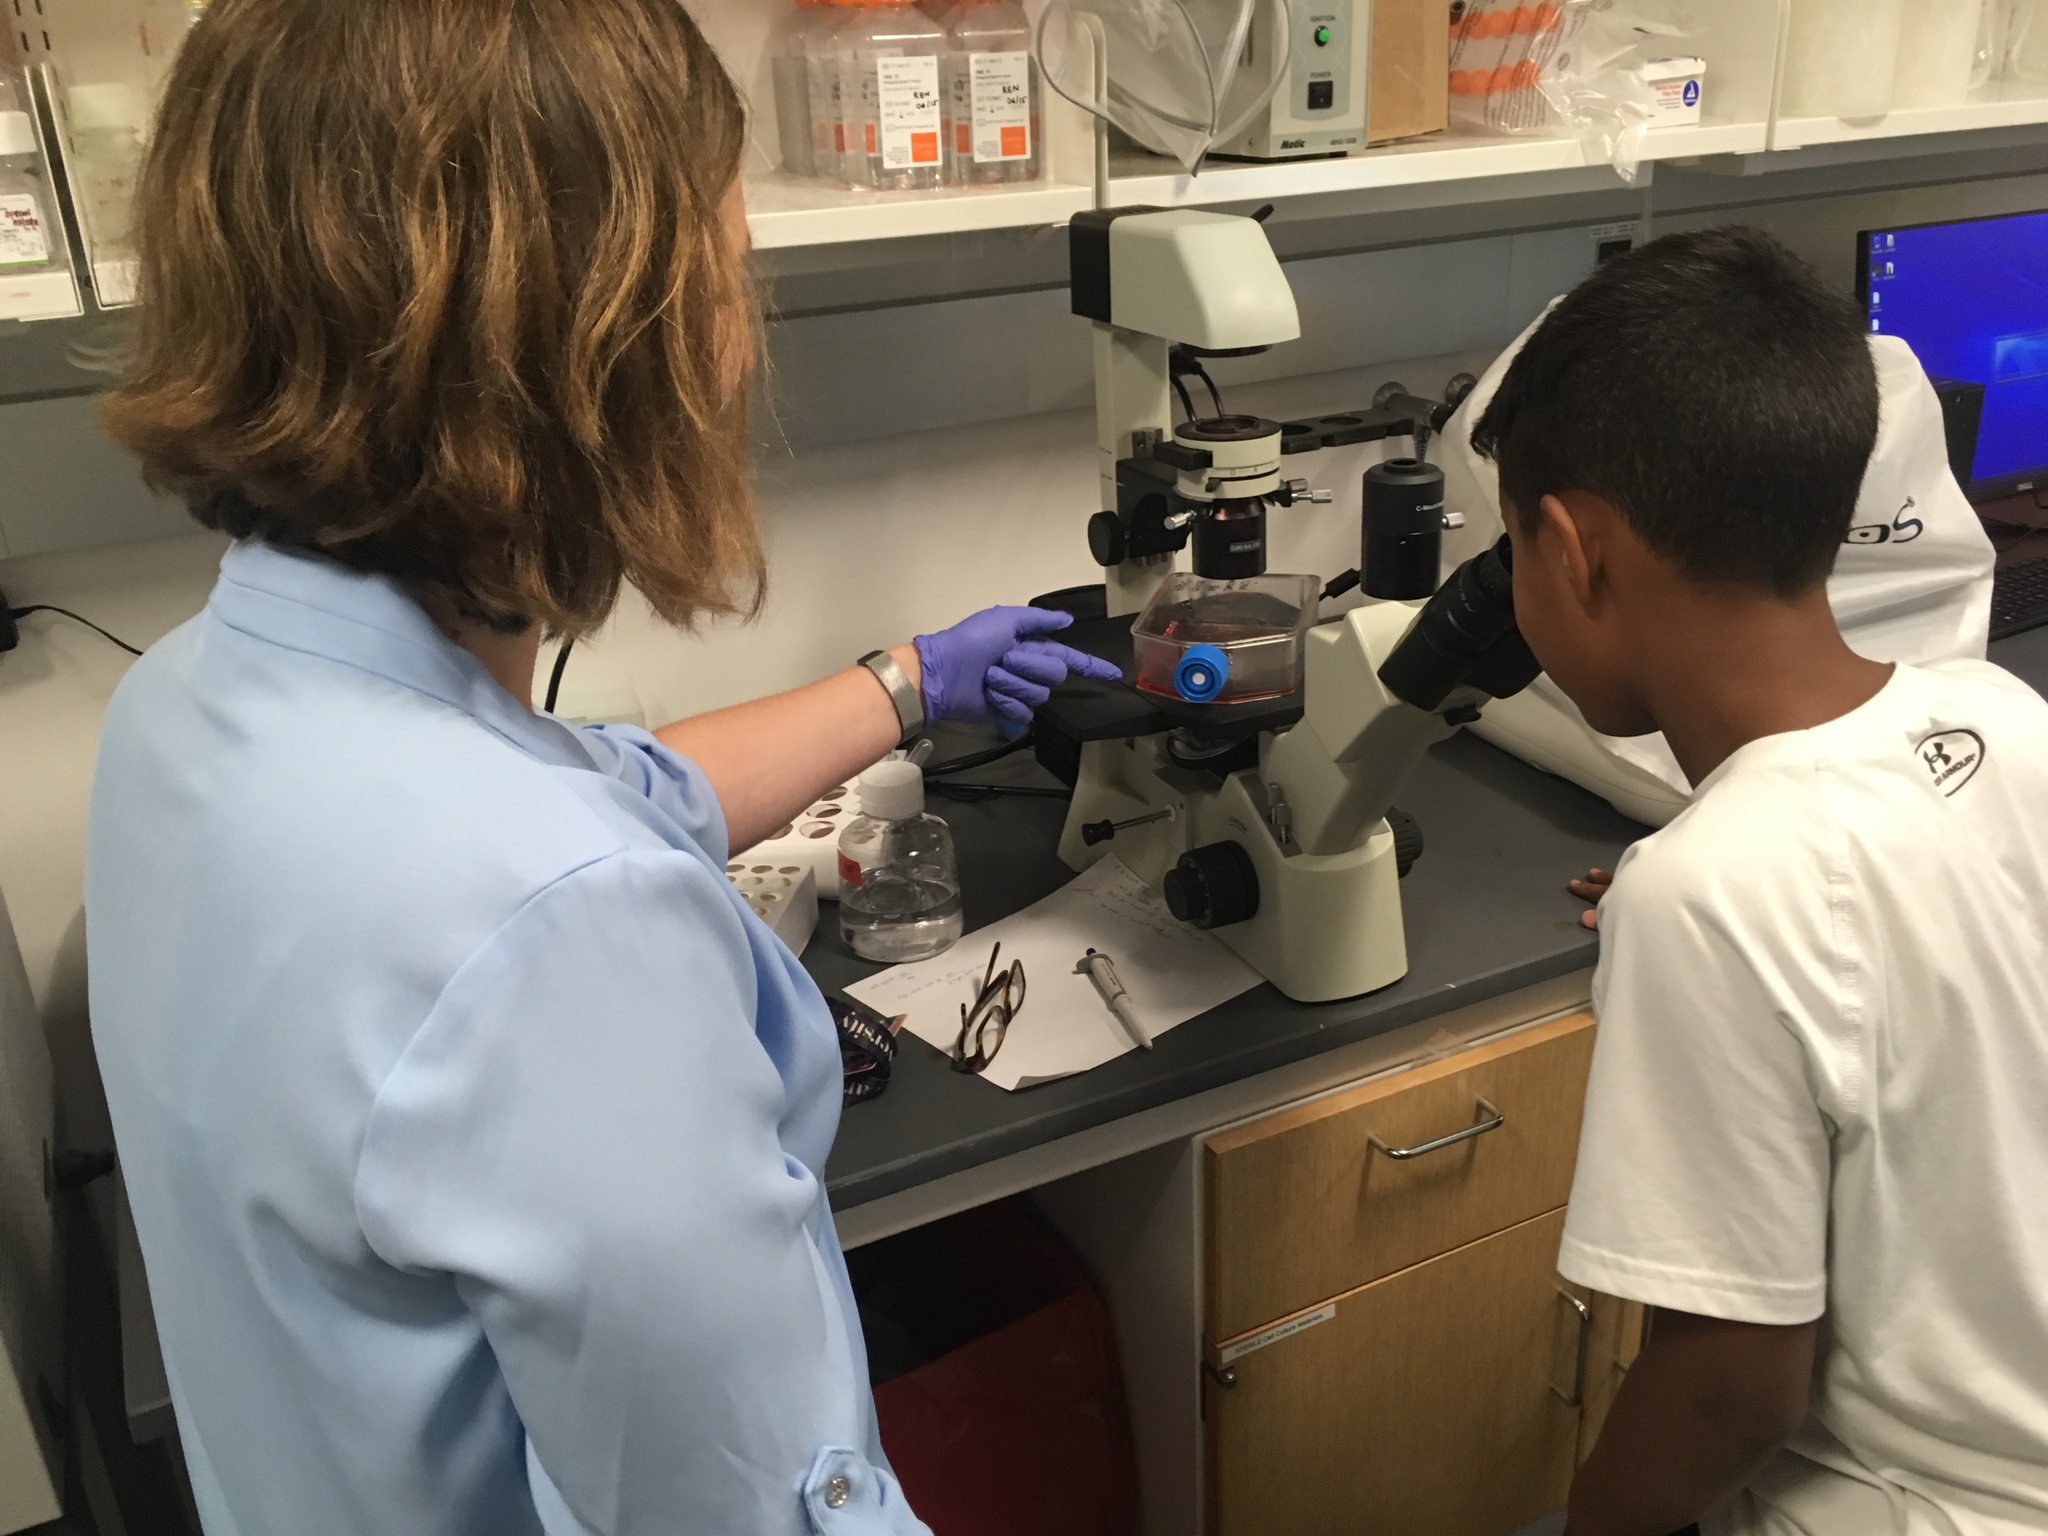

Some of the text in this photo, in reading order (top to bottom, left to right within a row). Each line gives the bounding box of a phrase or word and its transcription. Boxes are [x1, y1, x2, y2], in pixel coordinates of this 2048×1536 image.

[1310, 71, 1332, 79] POWER
[1002, 84, 1020, 94] REN
[1281, 139, 1305, 149] Motic
